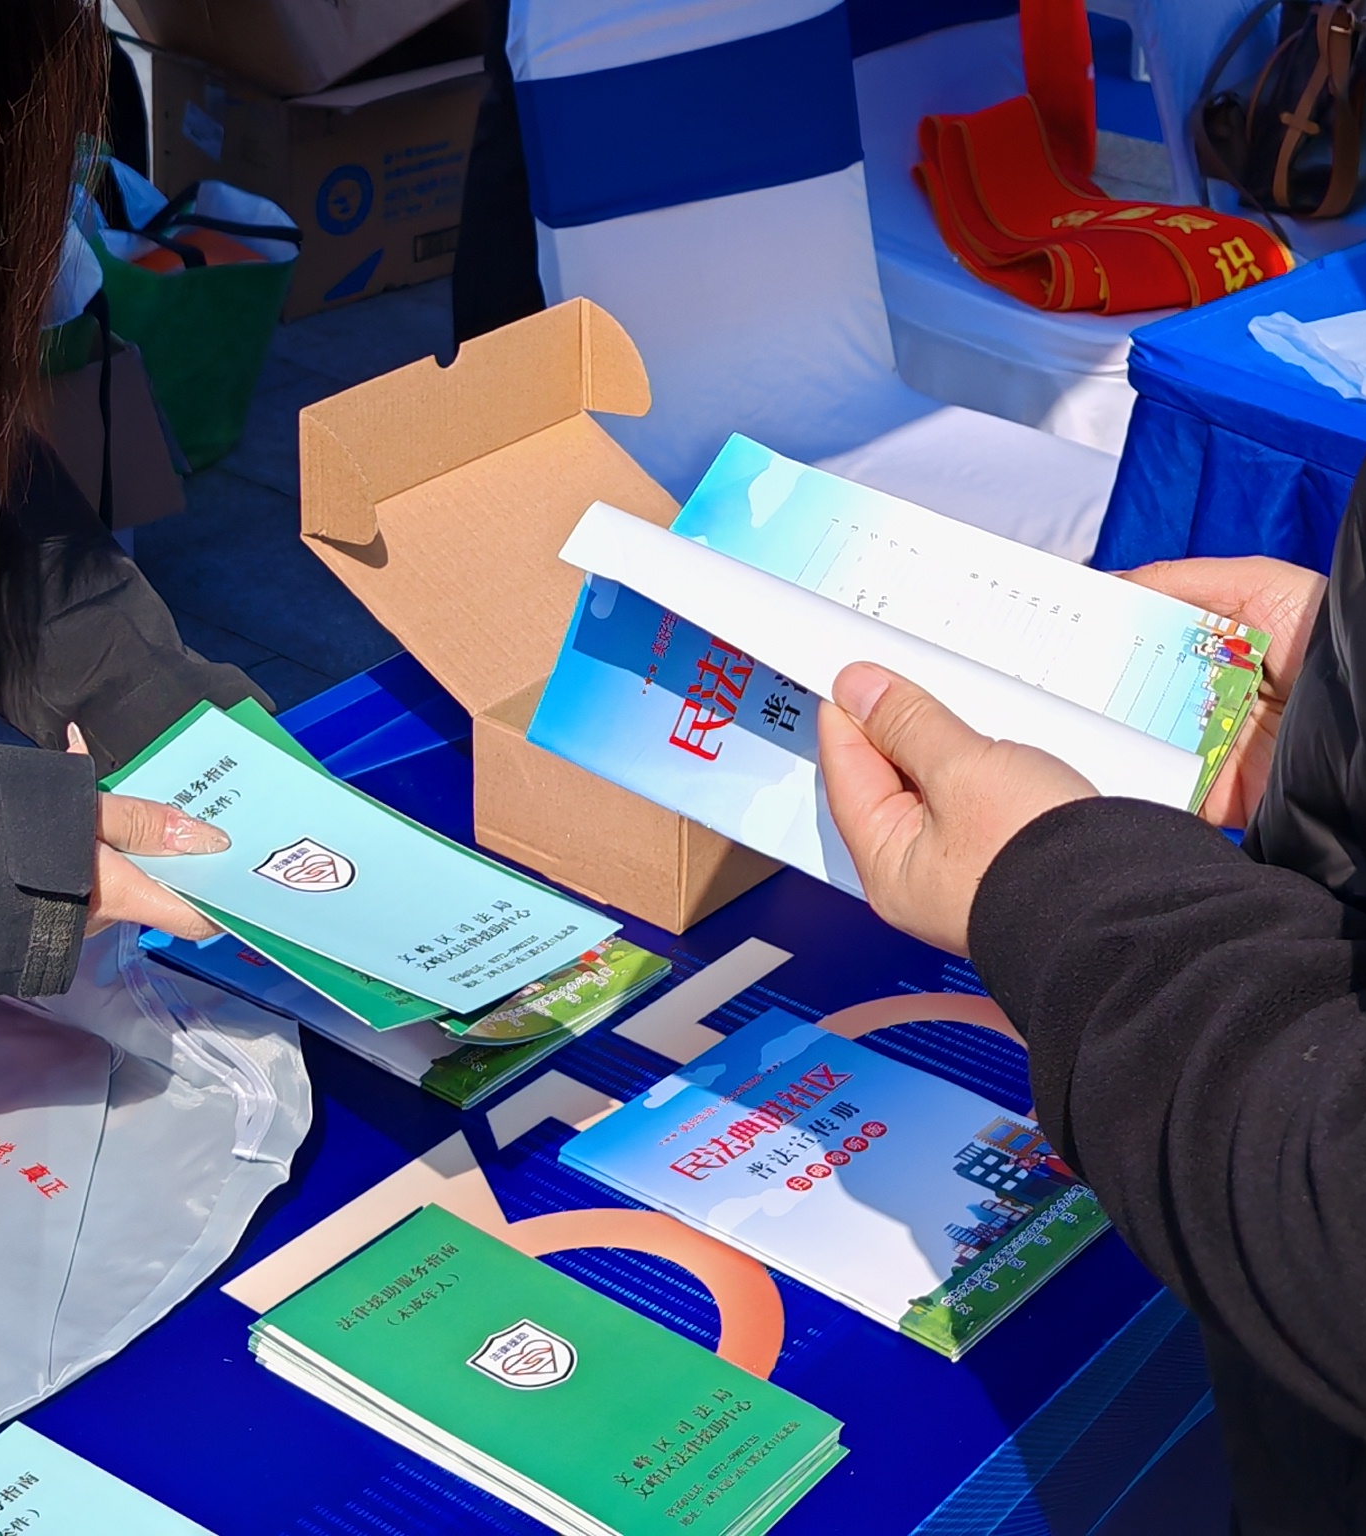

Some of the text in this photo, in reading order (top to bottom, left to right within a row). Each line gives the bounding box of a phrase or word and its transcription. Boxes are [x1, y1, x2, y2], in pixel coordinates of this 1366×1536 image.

[397, 900, 514, 965] 文峰区司法局
[668, 1060, 855, 1182] 民法典进社区
[744, 1100, 862, 1180] 普法宣传册
[335, 1242, 461, 1332] 法律援助服务指南
[613, 1386, 734, 1491] 文峰区司法局
[634, 1398, 753, 1500] 文峰区法律援助中心
